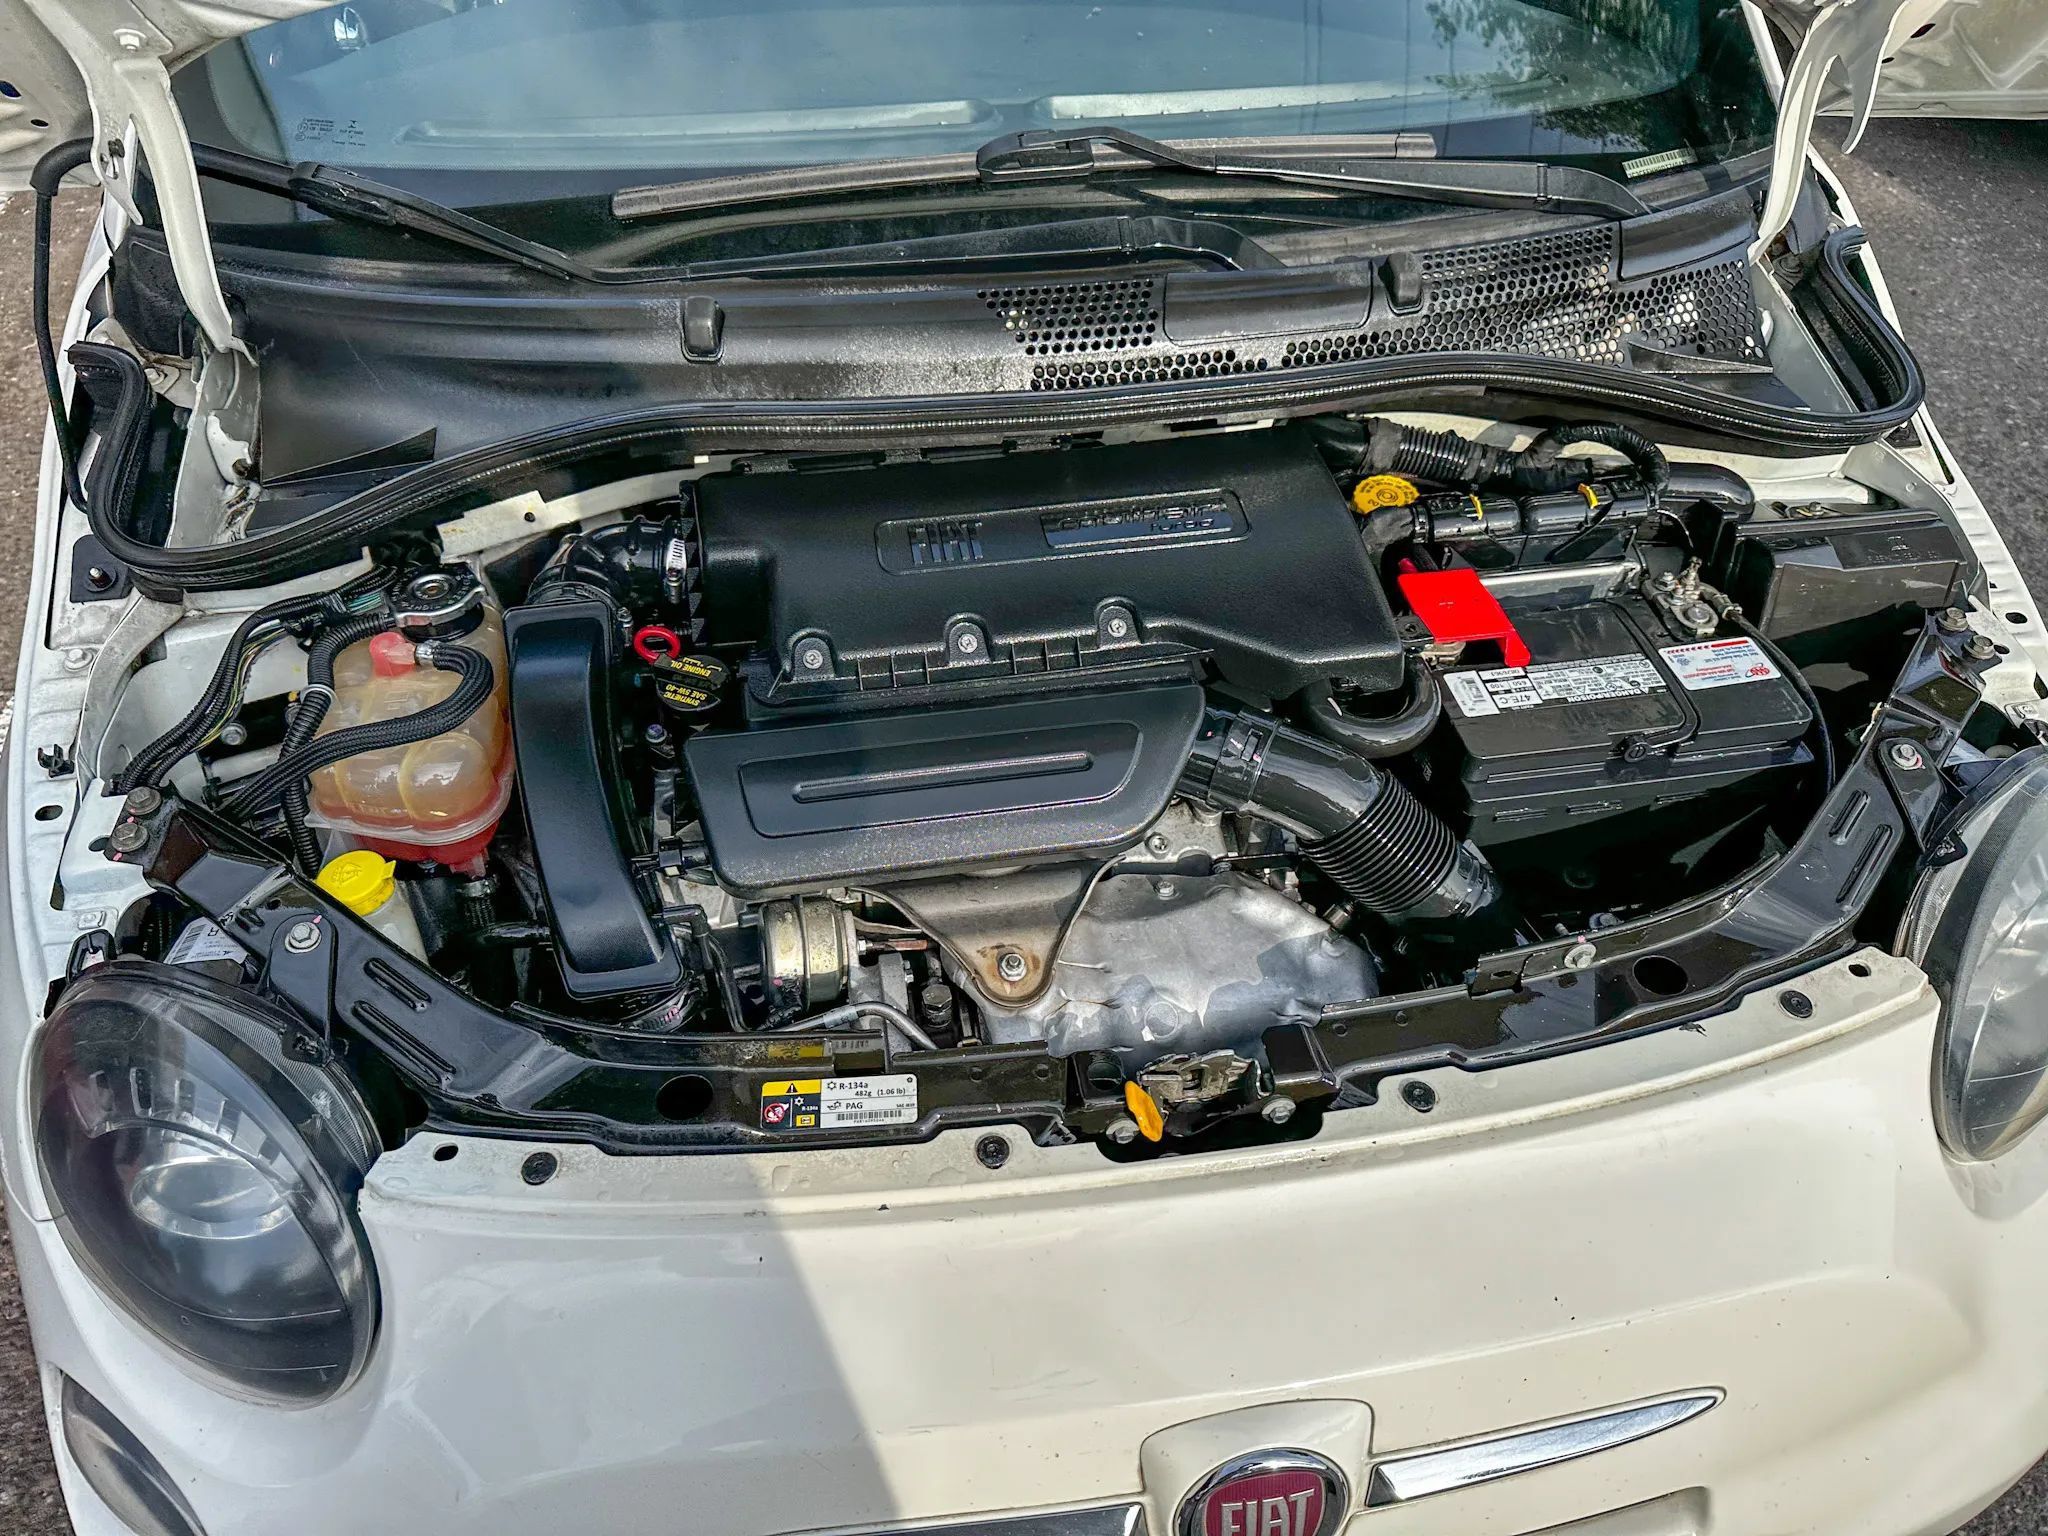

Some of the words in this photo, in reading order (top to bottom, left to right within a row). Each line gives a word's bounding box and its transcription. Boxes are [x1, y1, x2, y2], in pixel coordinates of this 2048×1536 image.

[908, 520, 983, 566] FIAT
[671, 660, 683, 669] OIL
[682, 665, 712, 677] ENGINE
[666, 684, 691, 696] 5W-40
[691, 690, 708, 701] SAE
[663, 691, 700, 706] SYNTHETIC
[839, 1082, 869, 1090] R-134a
[896, 1087, 906, 1095] lb)
[845, 1102, 864, 1110] PAG
[1221, 1488, 1316, 1536] FIAT
